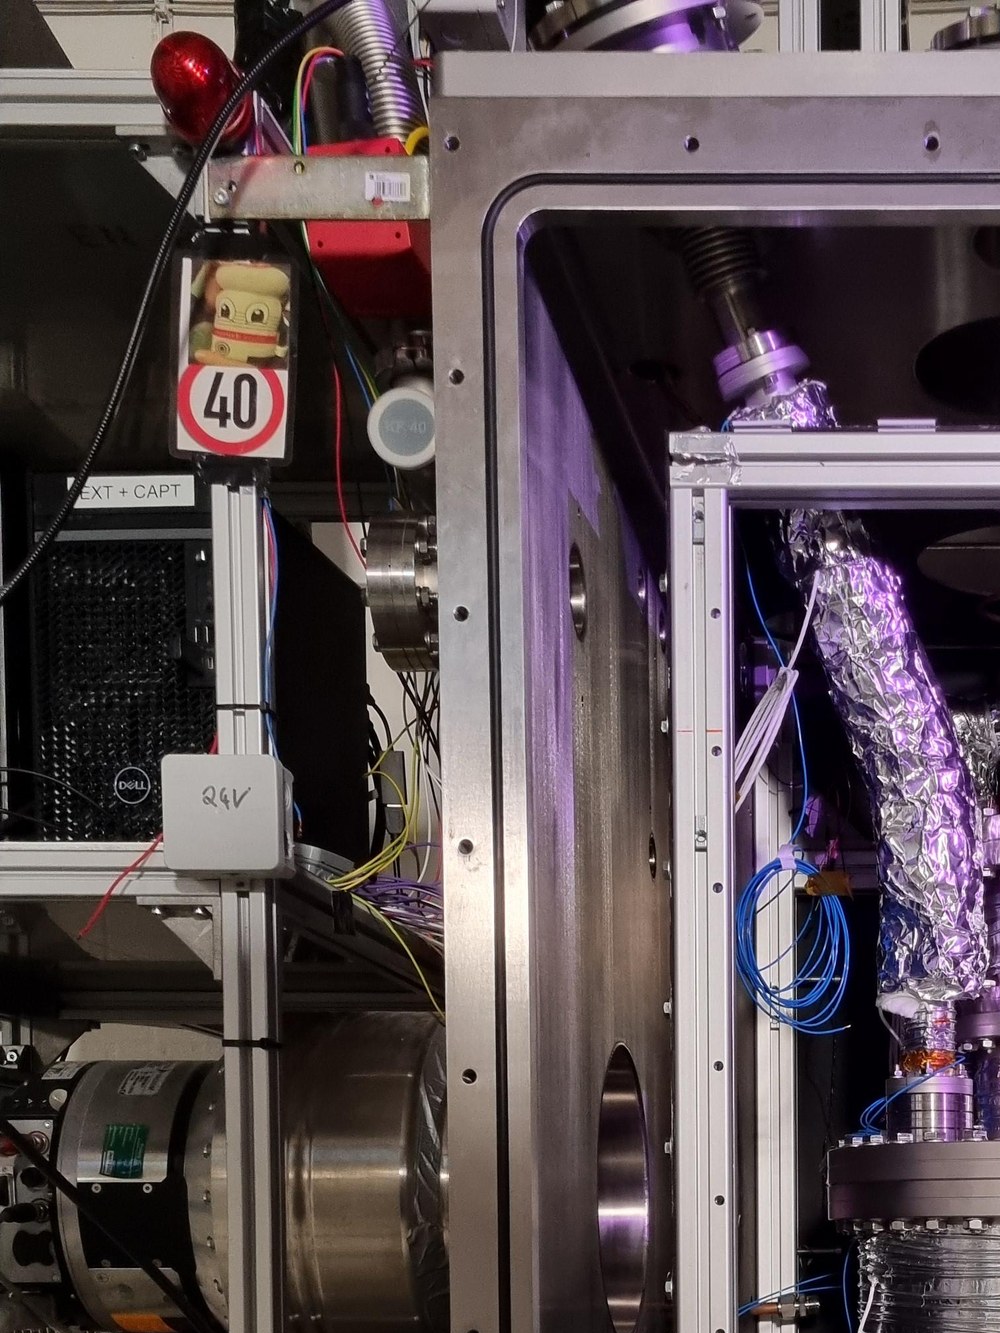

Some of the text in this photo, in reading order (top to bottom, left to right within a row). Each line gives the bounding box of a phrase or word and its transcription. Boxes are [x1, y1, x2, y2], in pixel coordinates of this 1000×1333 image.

[203, 371, 258, 430] 40
[80, 485, 114, 500] EXT
[133, 483, 181, 499] CAPT
[118, 780, 147, 791] DELL
[202, 785, 252, 810] 24V
